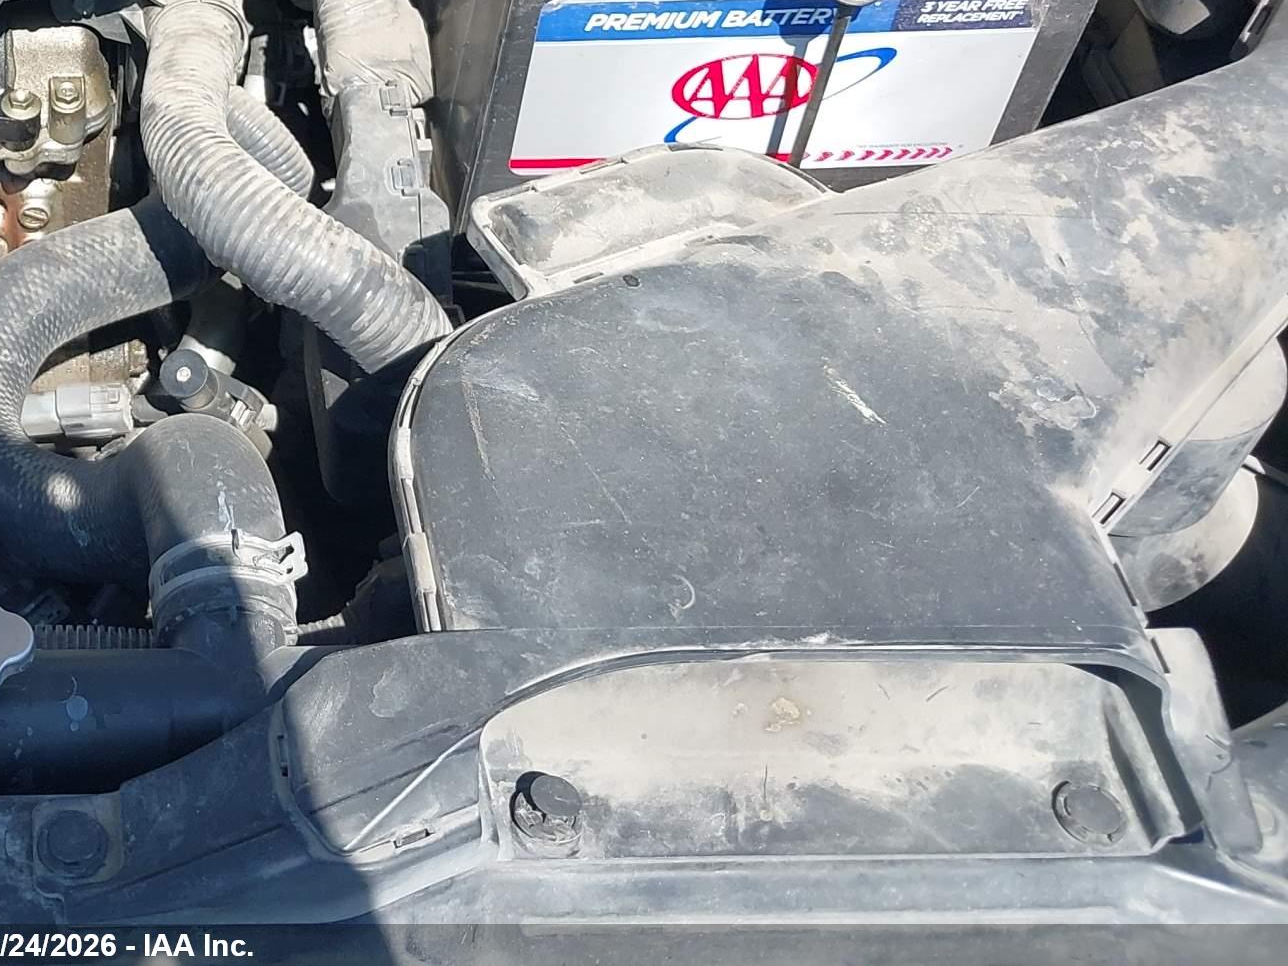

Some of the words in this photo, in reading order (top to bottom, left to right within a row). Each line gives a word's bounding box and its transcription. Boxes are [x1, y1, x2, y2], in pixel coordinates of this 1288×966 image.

[920, 1, 936, 13] 3
[936, 0, 982, 12] YEAR
[584, 10, 723, 32] PREMIUM
[673, 54, 818, 119] AAA
